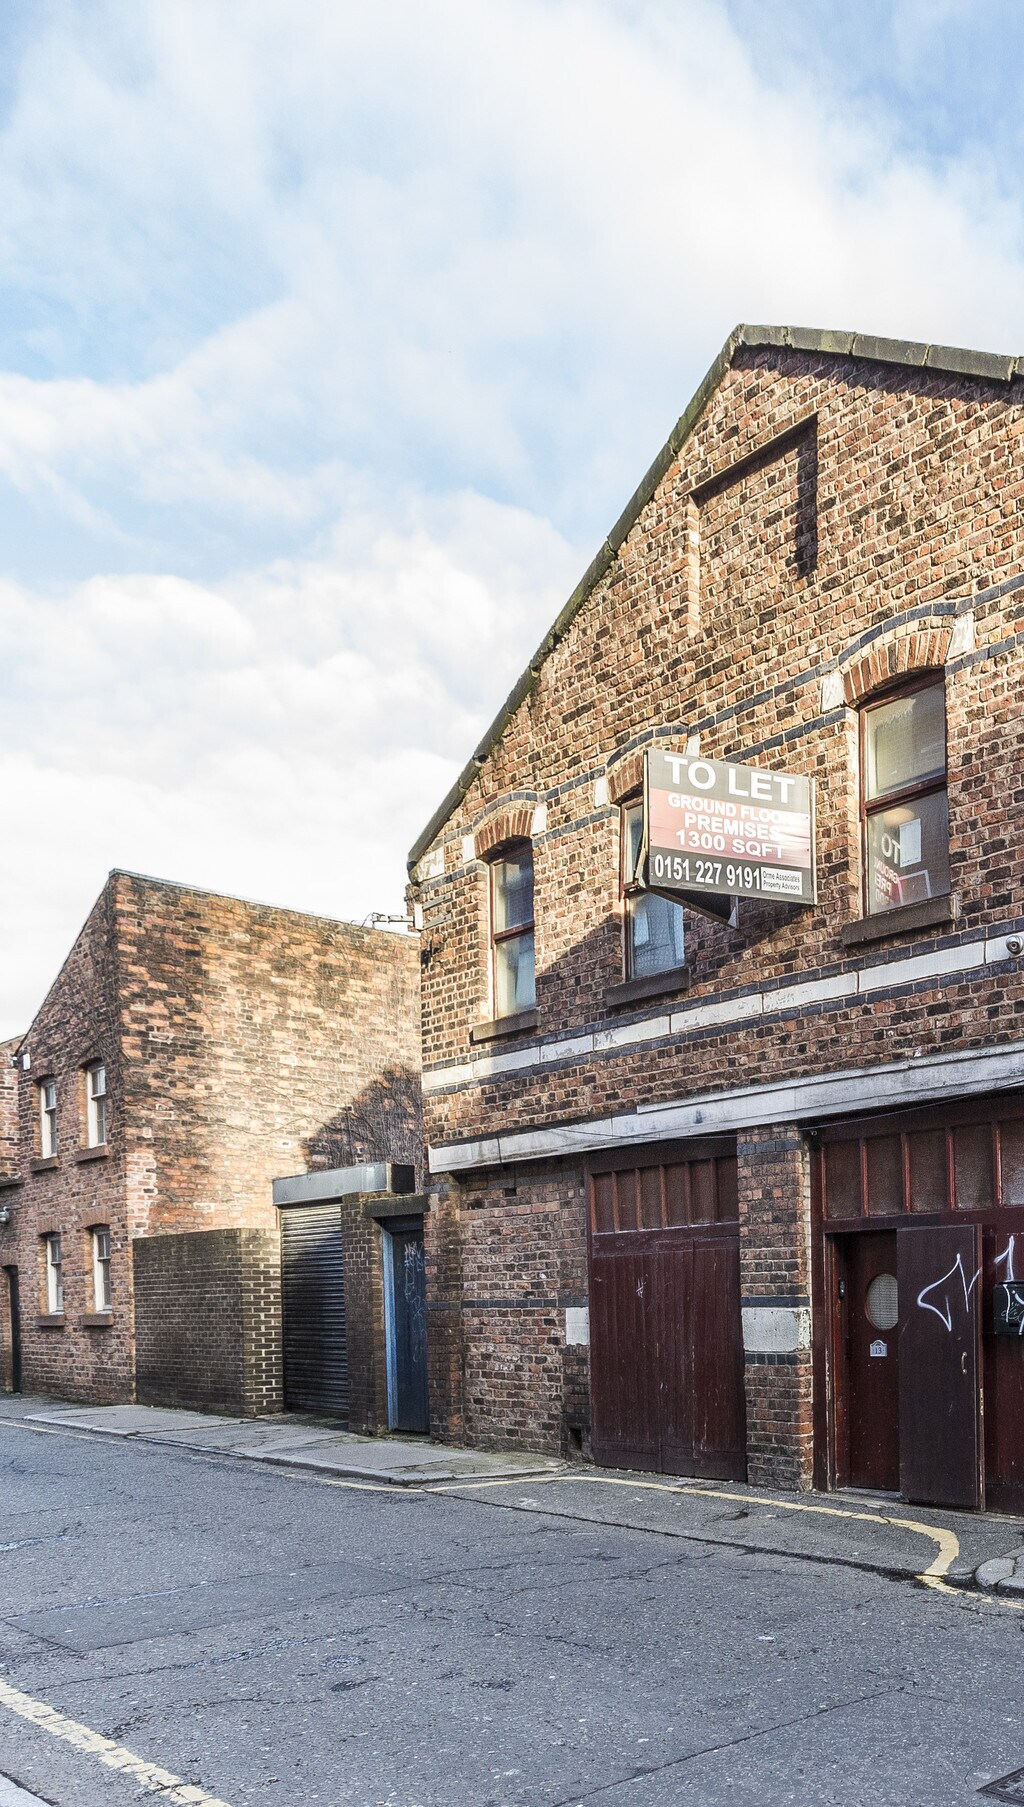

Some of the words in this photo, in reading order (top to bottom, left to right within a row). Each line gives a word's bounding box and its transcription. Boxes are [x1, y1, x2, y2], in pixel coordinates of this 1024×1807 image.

[664, 755, 716, 790] TO
[728, 767, 795, 804] LET
[668, 793, 737, 817] GROUND
[740, 804, 787, 826] FLOO
[684, 812, 783, 841] PREMISES
[676, 829, 726, 851] 1300
[732, 839, 784, 858] SQFT
[654, 854, 690, 881] 0151
[695, 860, 722, 884] 227
[726, 864, 760, 890] 9191
[763, 879, 781, 890] Property
[782, 882, 800, 891] Advisors
[776, 873, 800, 883] Associates
